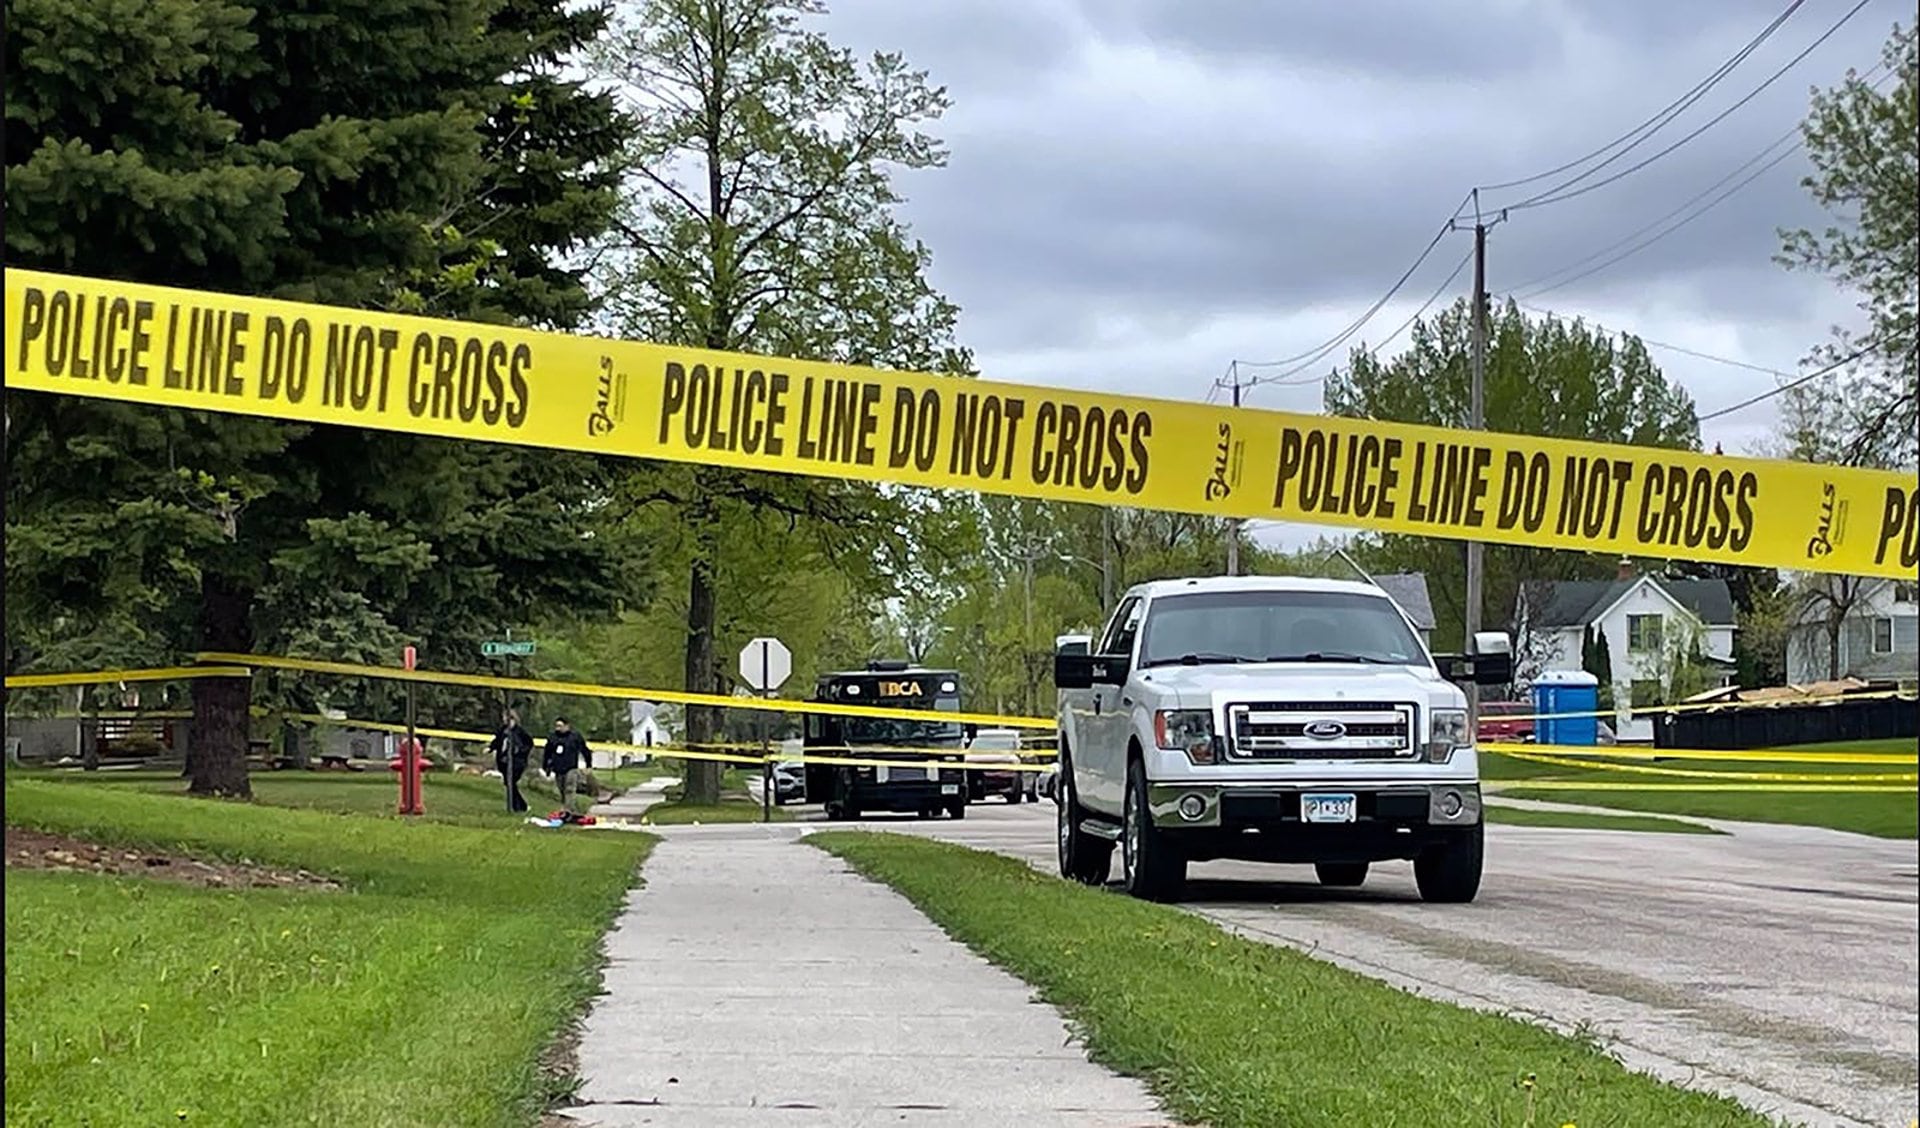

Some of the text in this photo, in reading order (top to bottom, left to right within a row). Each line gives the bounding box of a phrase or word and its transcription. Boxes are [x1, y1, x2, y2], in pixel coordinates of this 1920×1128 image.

[18, 287, 154, 386] POLICE
[164, 304, 250, 396] LINE
[259, 317, 310, 403] DO
[323, 324, 398, 411] NOT
[407, 331, 532, 429] CROSS
[659, 361, 789, 457] POLICE
[797, 377, 881, 465] LINE
[889, 387, 940, 472] DO
[949, 393, 1025, 480] NOT
[1031, 401, 1153, 495] CROSS
[1273, 428, 1403, 519] POLICE
[1408, 442, 1492, 527] LINE
[1496, 451, 1550, 533] DO
[1555, 456, 1633, 541] NOT
[1635, 464, 1758, 553] CROSS
